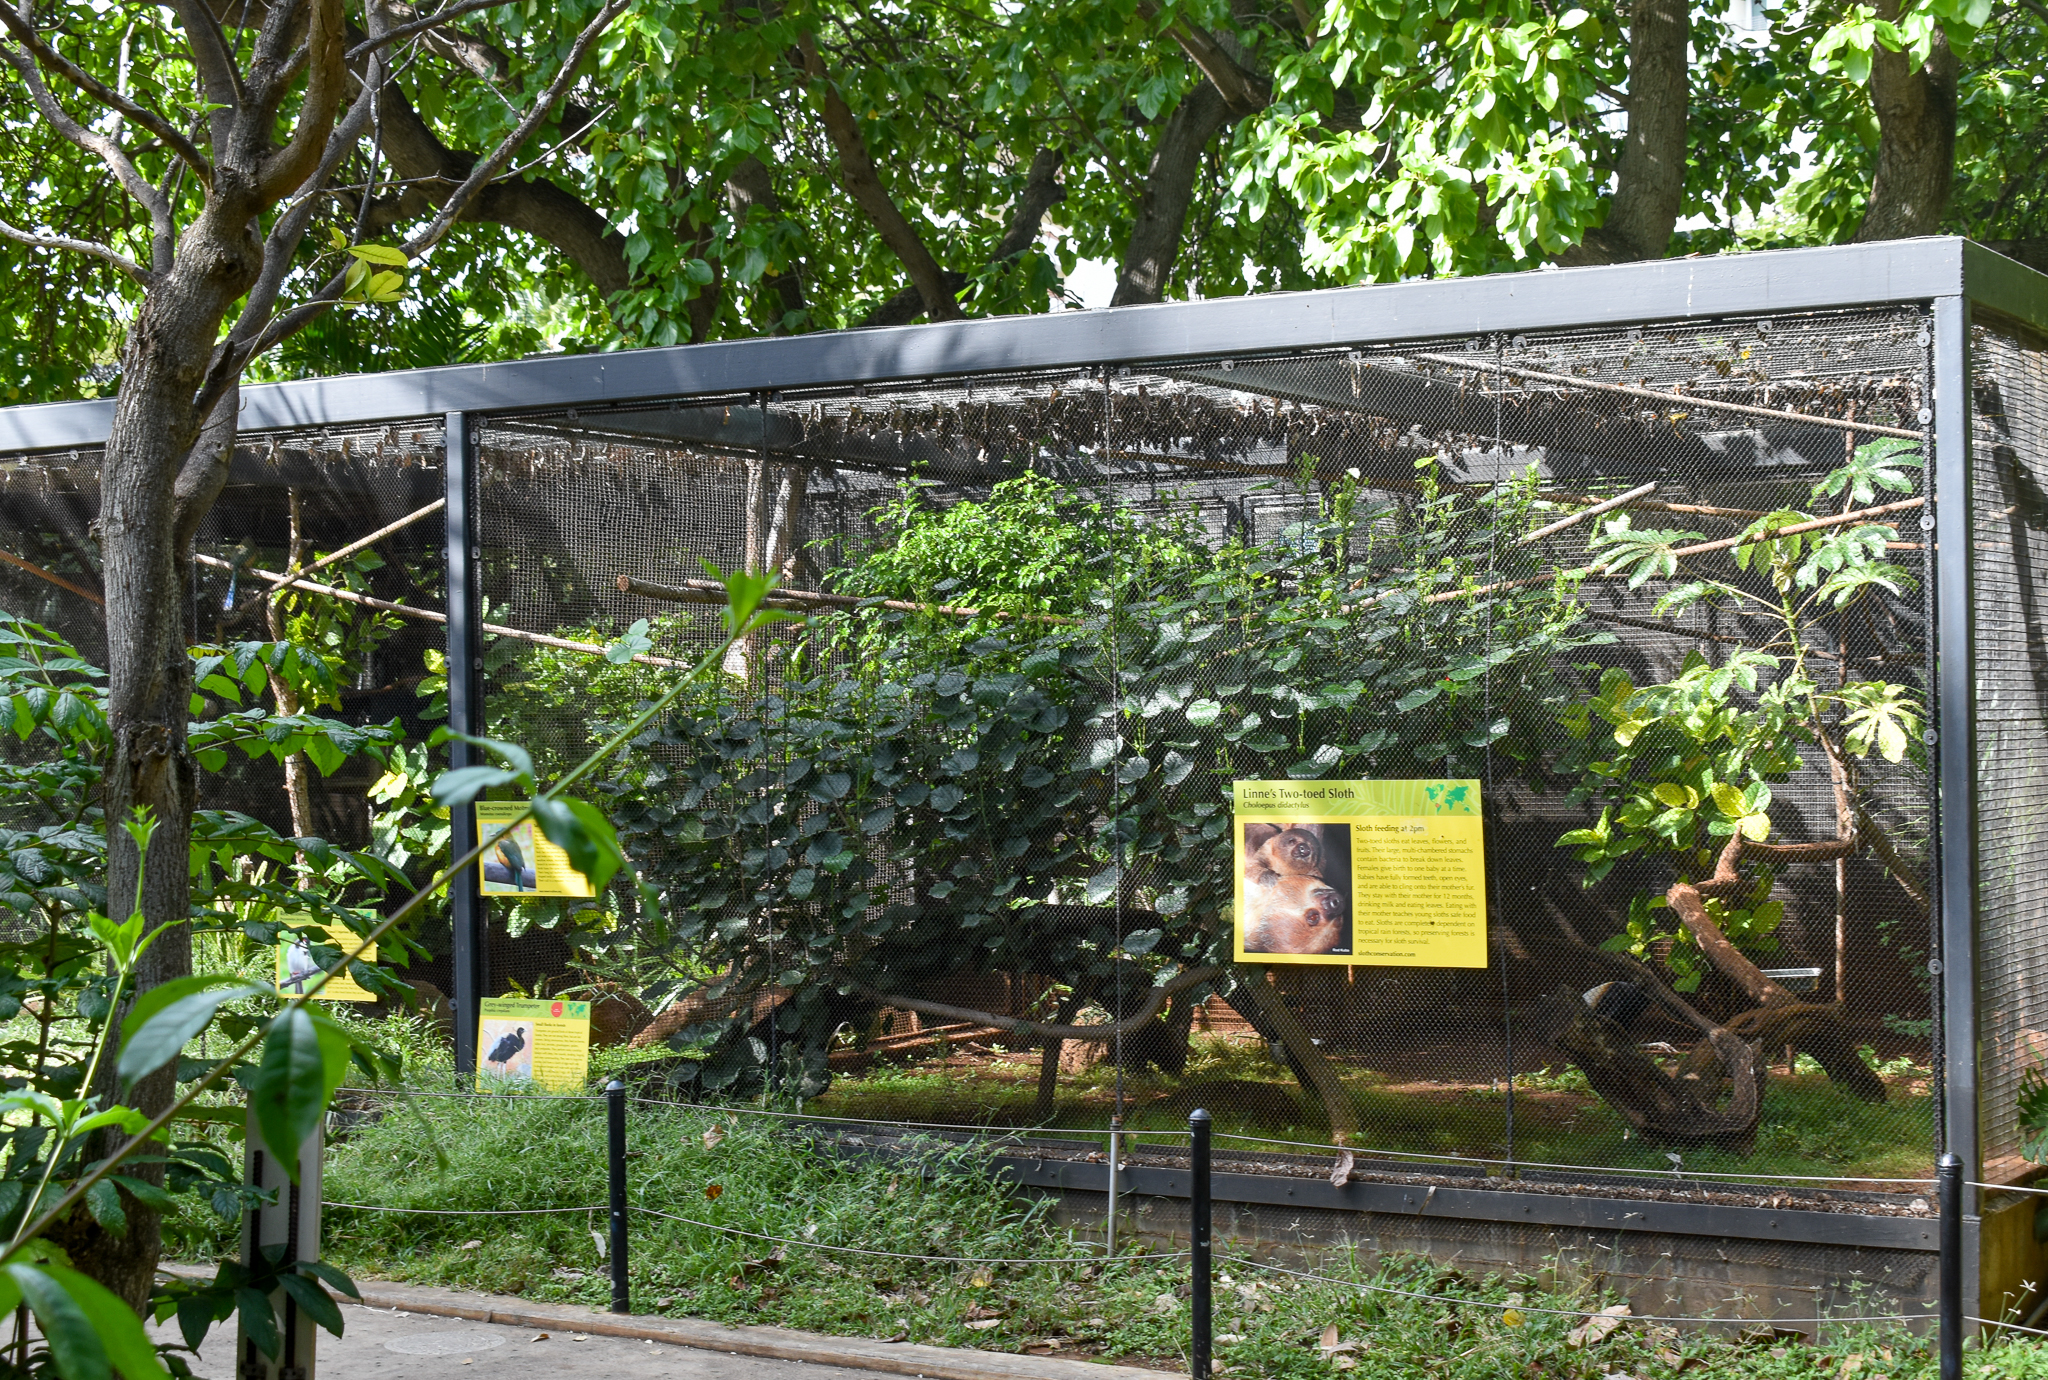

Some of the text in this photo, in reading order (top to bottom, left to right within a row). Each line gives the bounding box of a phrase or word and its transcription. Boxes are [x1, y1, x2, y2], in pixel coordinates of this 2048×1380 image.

[1243, 788, 1355, 799] Linne's Two-toed Sloth
[1243, 801, 1310, 810] Choloepus didactylus
[1374, 825, 1399, 833] feeding
[1409, 825, 1424, 834] 2pm
[1380, 865, 1391, 873] give
[1390, 874, 1401, 882] fully
[1399, 883, 1413, 891] cling
[1436, 920, 1466, 928] dependent
[1421, 929, 1449, 937] preserving
